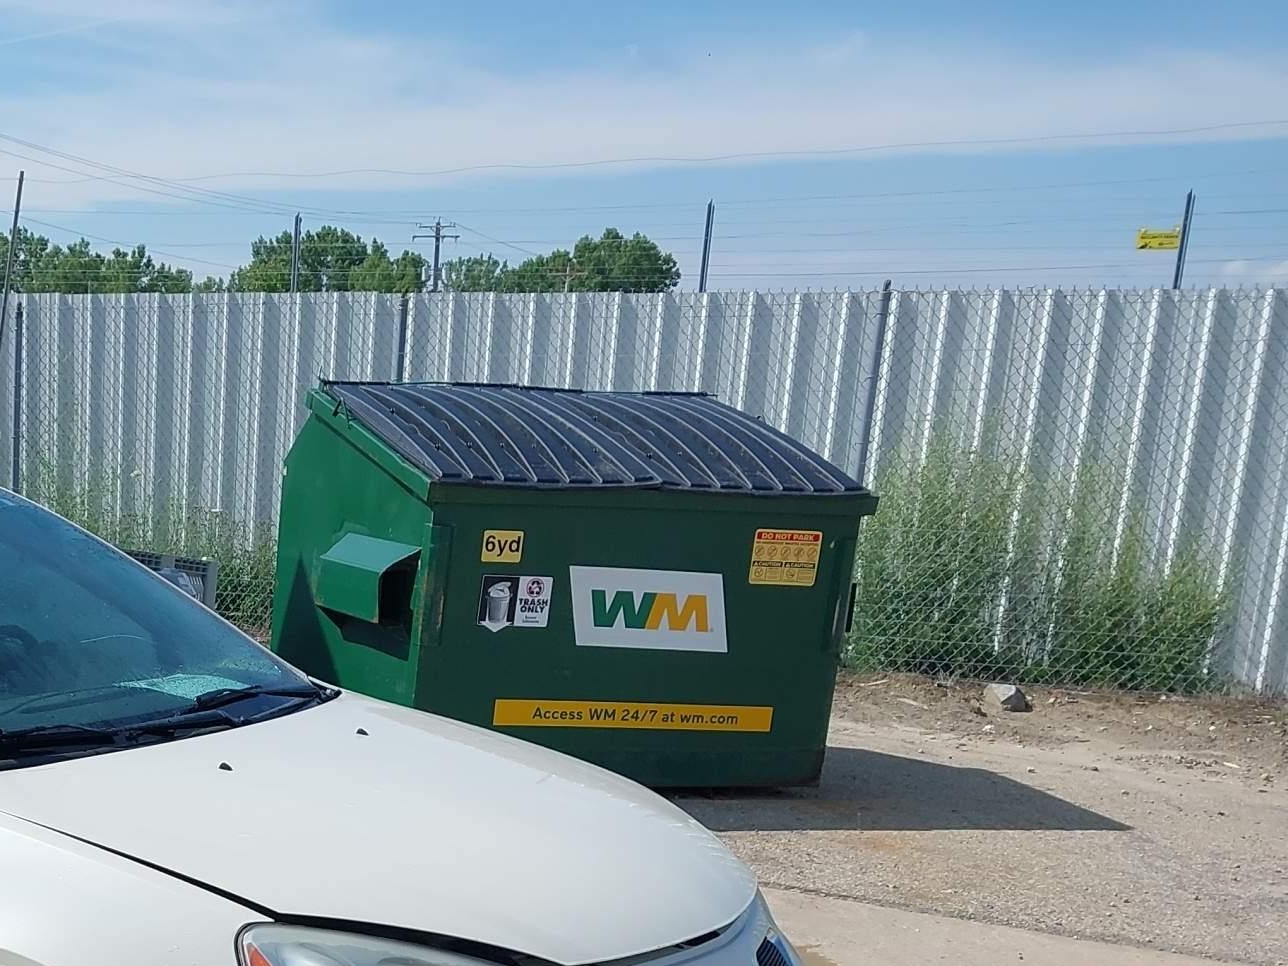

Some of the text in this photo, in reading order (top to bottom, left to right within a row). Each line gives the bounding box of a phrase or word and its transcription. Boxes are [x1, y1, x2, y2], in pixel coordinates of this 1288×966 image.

[761, 532, 774, 540] DO
[485, 535, 521, 557] 6yd
[519, 598, 548, 606] TRASH
[591, 589, 708, 632] WM
[532, 707, 738, 724] Access WM 24/7 at wm.com
